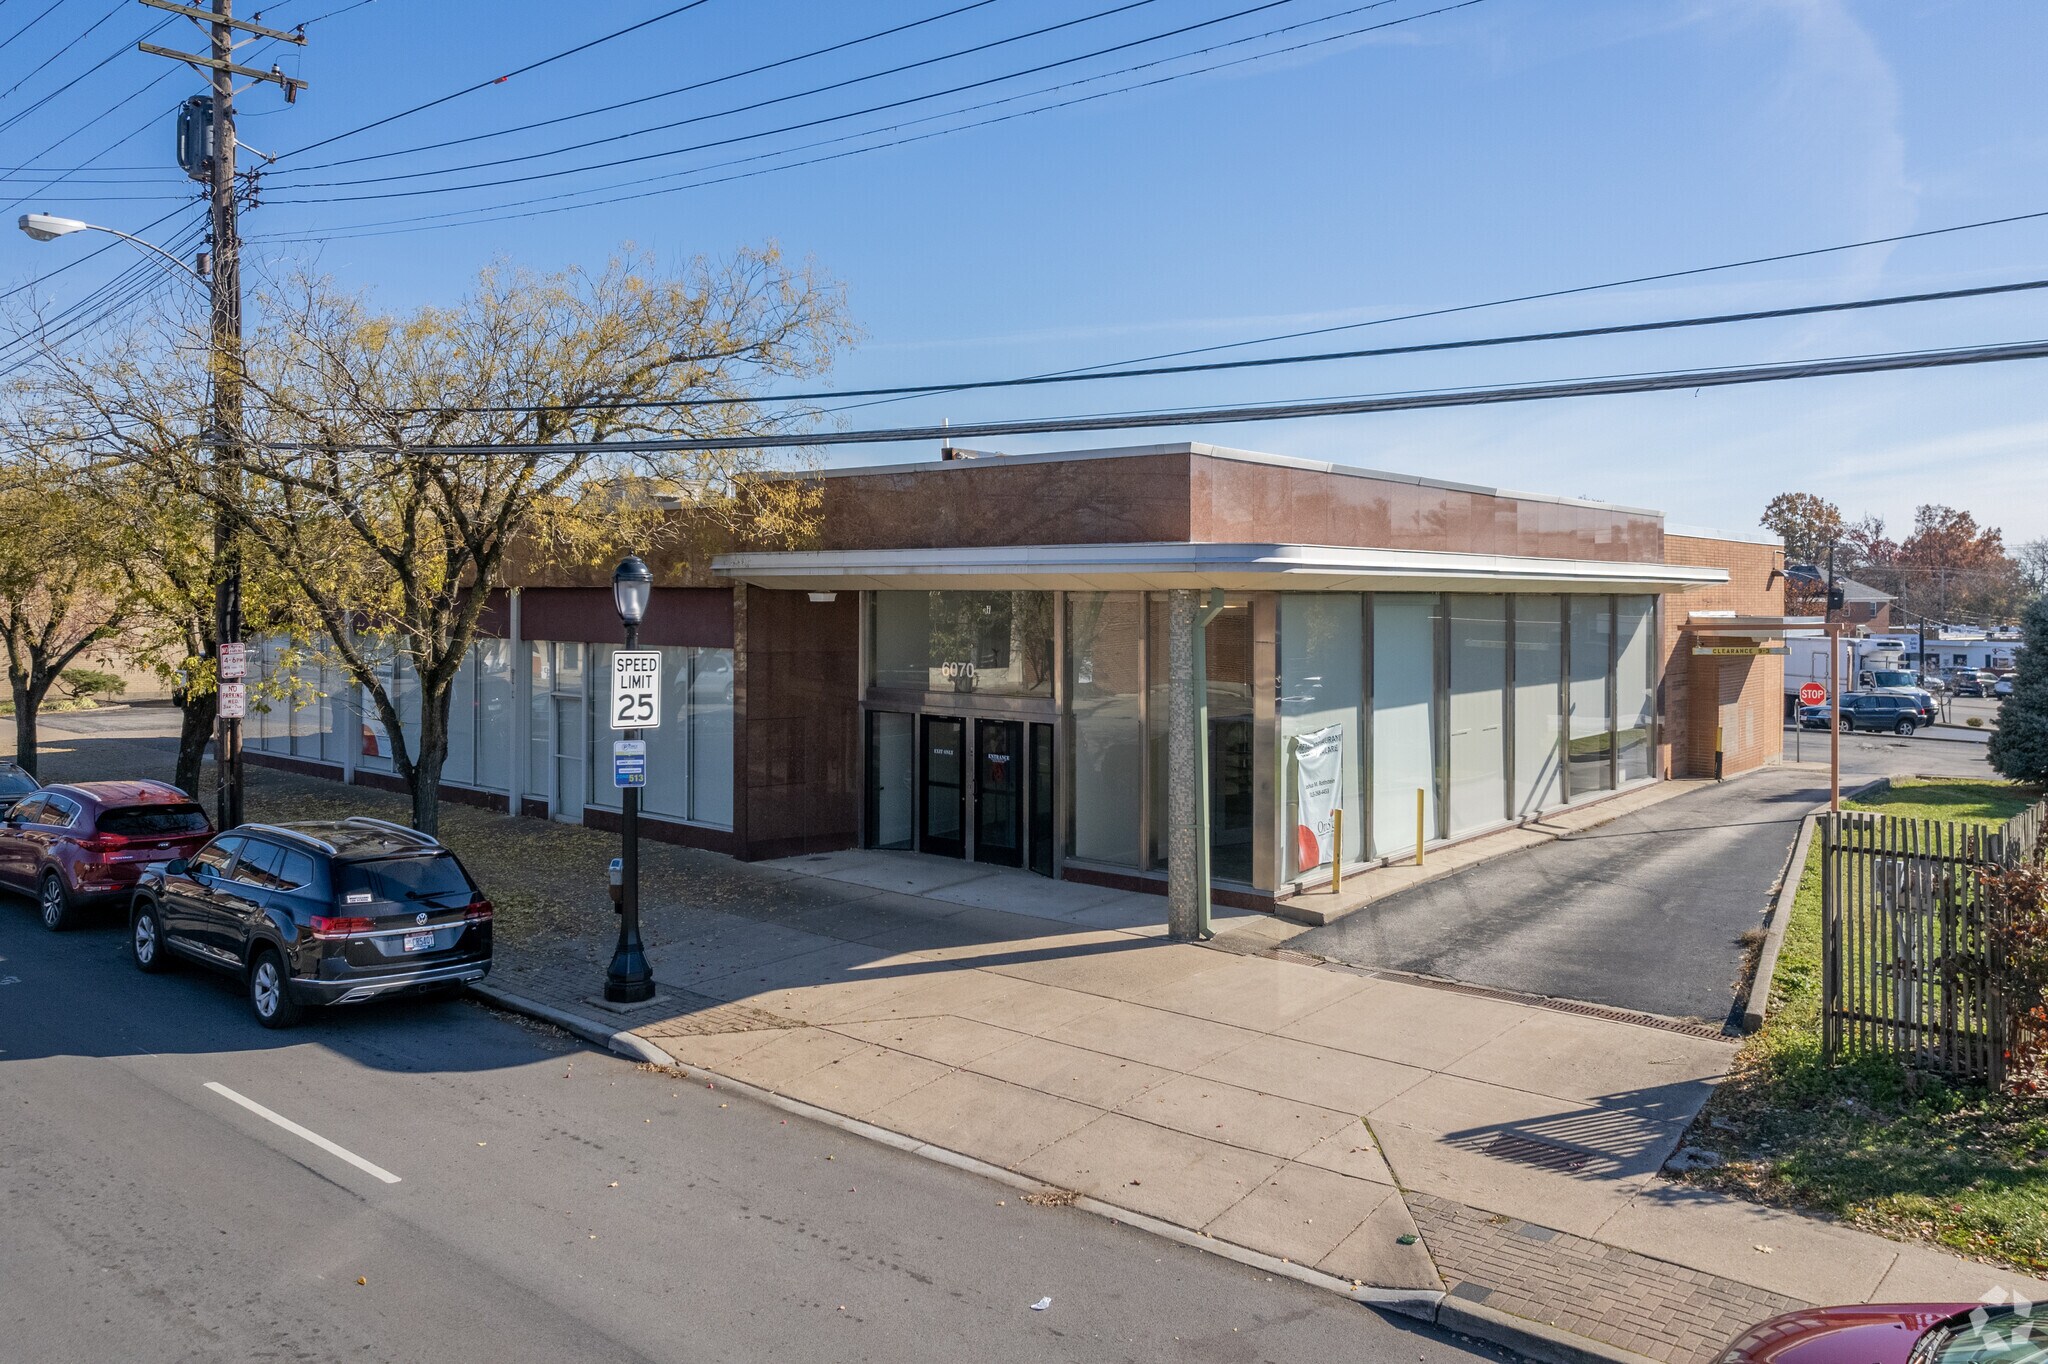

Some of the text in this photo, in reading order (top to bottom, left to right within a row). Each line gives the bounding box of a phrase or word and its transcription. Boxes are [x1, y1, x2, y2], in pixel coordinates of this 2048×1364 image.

[617, 658, 657, 672] SPEED
[941, 661, 975, 678] 6070
[621, 675, 652, 689] LIMIT
[1801, 689, 1824, 699] STOP
[618, 694, 654, 721] 25
[988, 753, 1010, 761] ENTRANCE
[629, 773, 644, 783] 513
